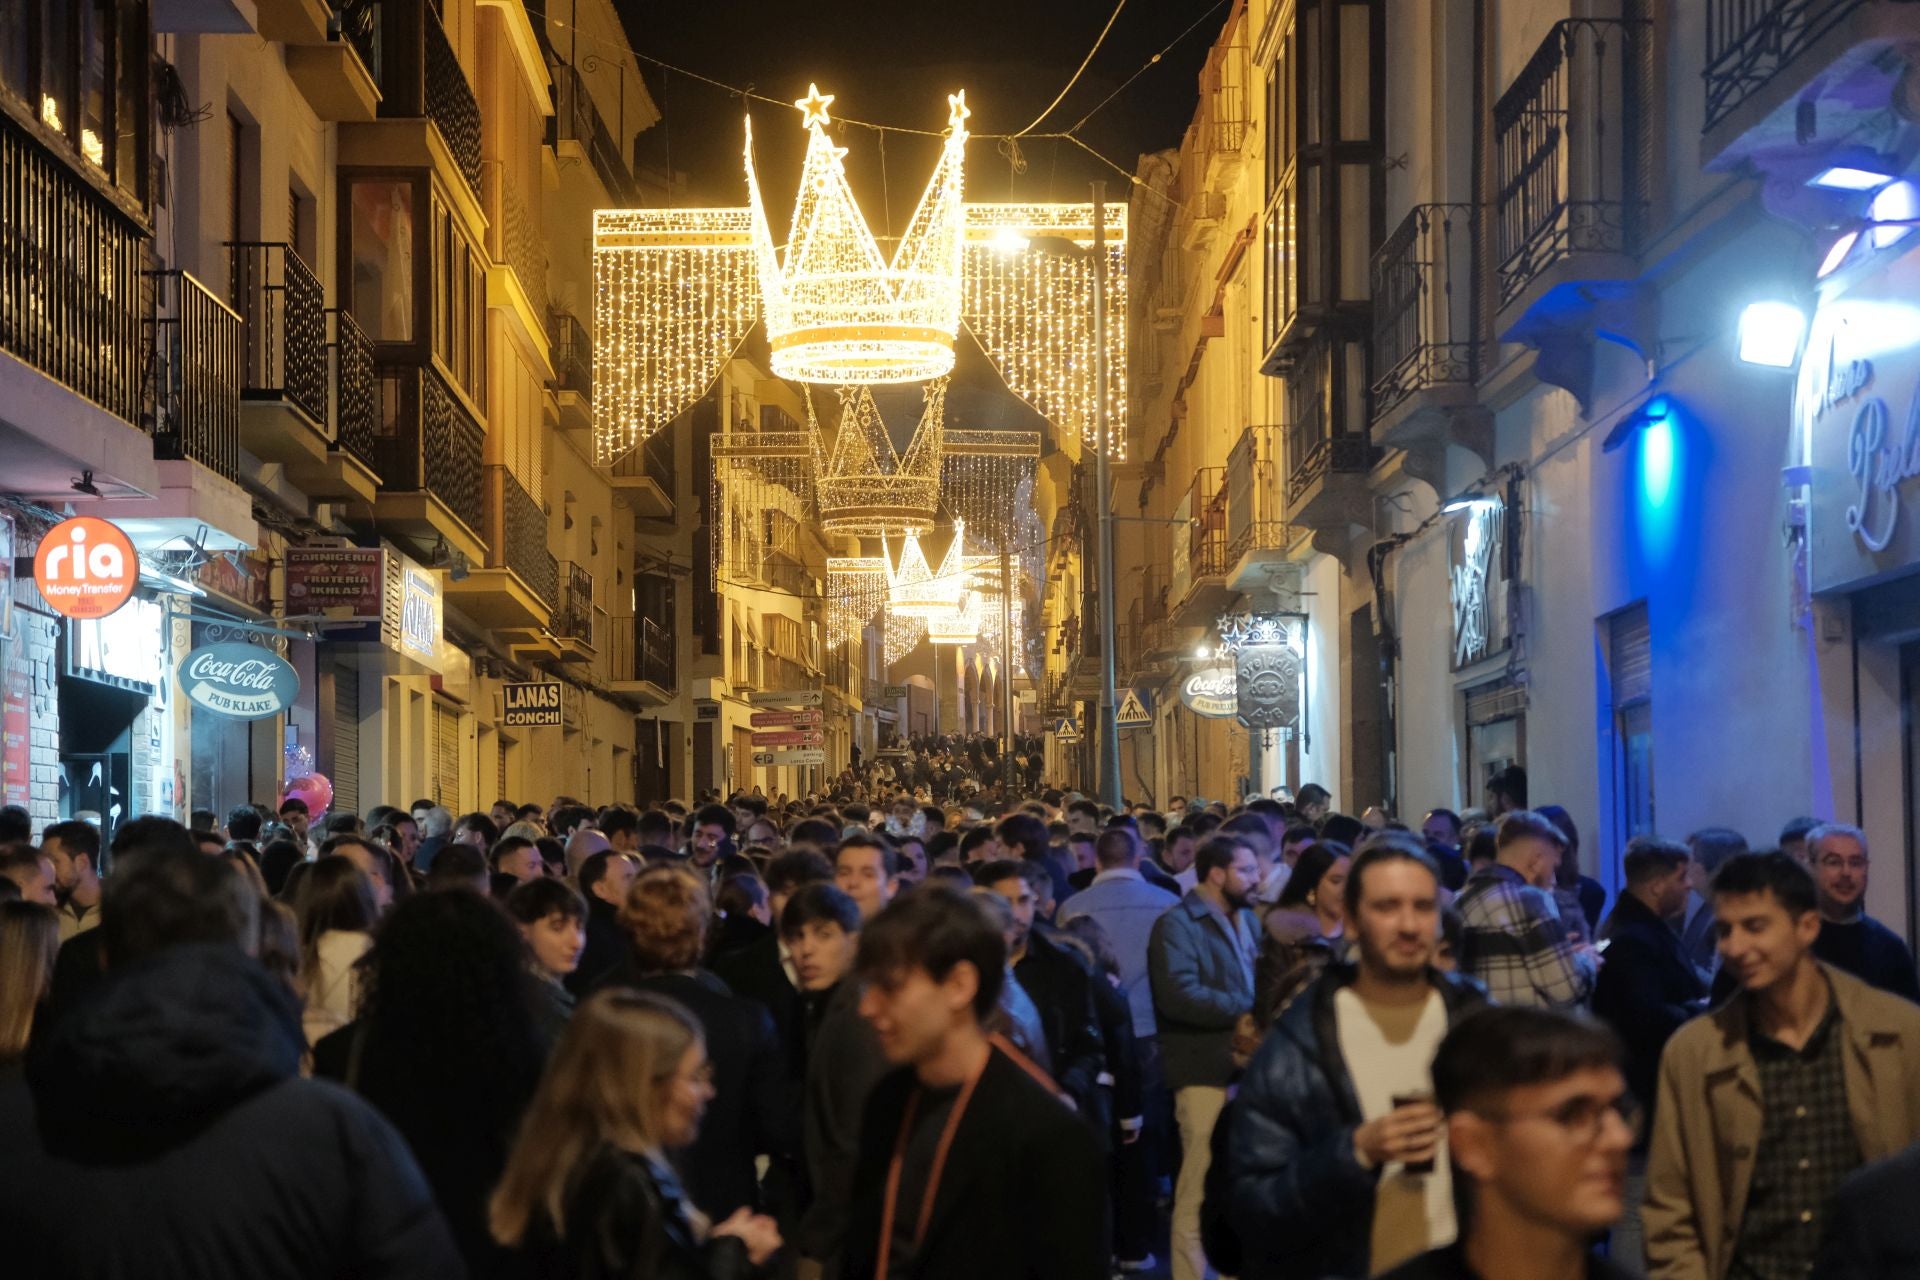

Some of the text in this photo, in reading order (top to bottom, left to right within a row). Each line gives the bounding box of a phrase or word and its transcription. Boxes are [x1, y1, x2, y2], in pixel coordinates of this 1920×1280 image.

[45, 526, 124, 580] ria
[330, 564, 339, 572] Y
[303, 575, 369, 584] FRUTERIA
[46, 582, 123, 596] Money Transfer
[311, 586, 361, 595] IKHLAS
[190, 652, 276, 690] Coca-Cola
[208, 692, 272, 712] PUB KLAKE
[506, 686, 558, 708] LANAS
[506, 712, 559, 725] CONCHI
